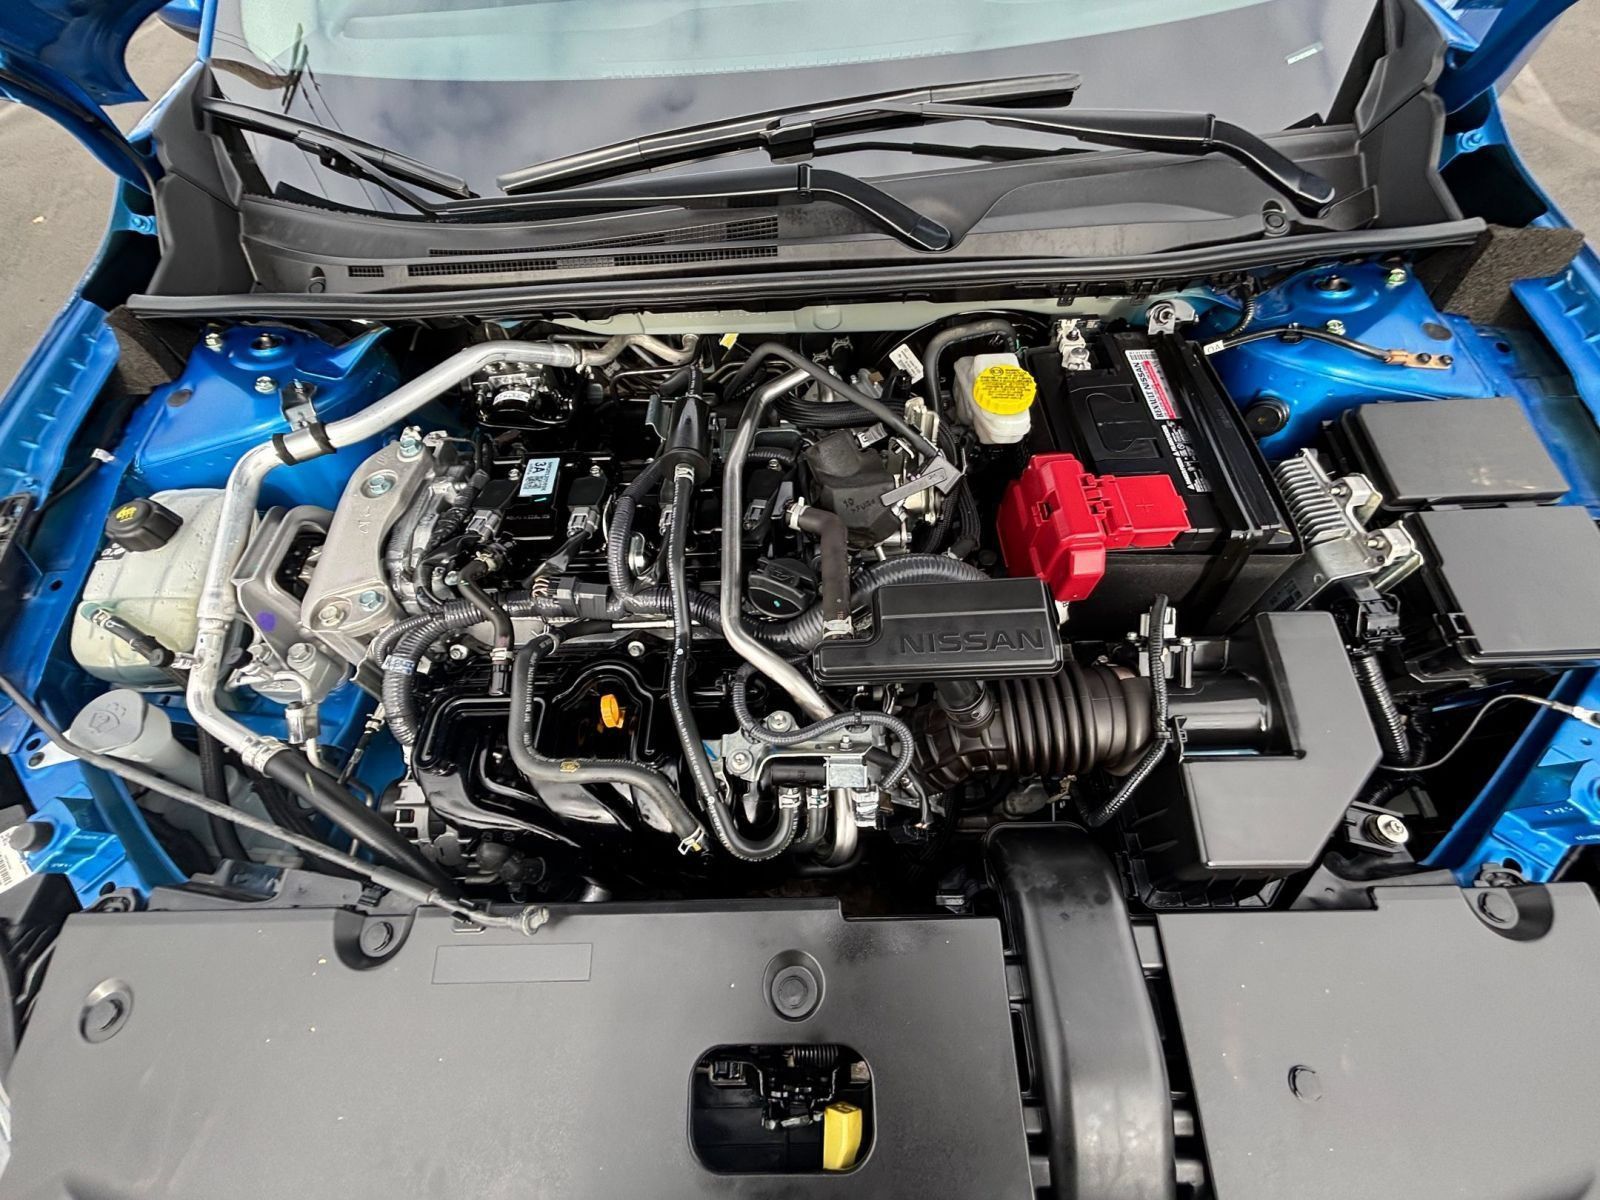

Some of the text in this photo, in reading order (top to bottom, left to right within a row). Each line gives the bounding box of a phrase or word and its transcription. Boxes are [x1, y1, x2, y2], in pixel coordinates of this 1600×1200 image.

[1132, 361, 1152, 390] NISSAN
[1146, 391, 1164, 418] RENAULT
[532, 461, 547, 474] 3A
[900, 629, 1045, 655] NISSAN
